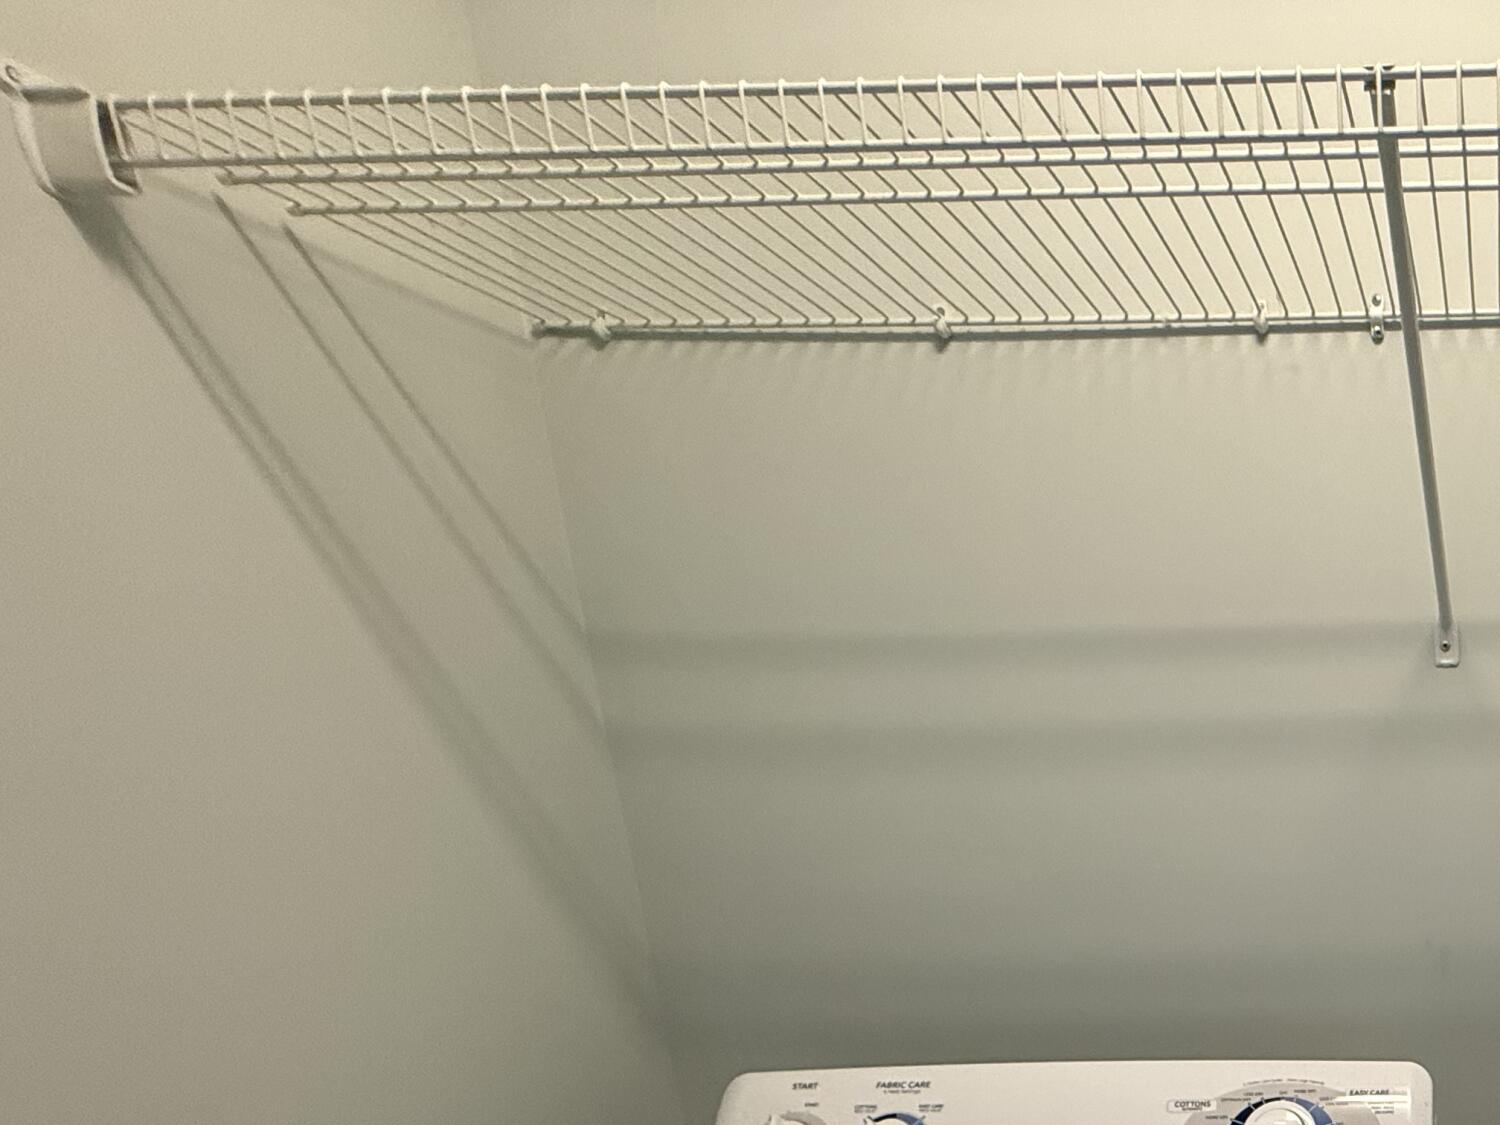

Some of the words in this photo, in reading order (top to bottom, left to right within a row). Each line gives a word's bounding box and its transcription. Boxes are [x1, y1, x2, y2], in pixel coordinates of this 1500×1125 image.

[791, 1082, 819, 1090] START
[875, 1081, 907, 1089] FABRIC
[908, 1080, 932, 1089] CARE
[1349, 1089, 1369, 1097] EASY
[1174, 1100, 1212, 1108] COTTONS
